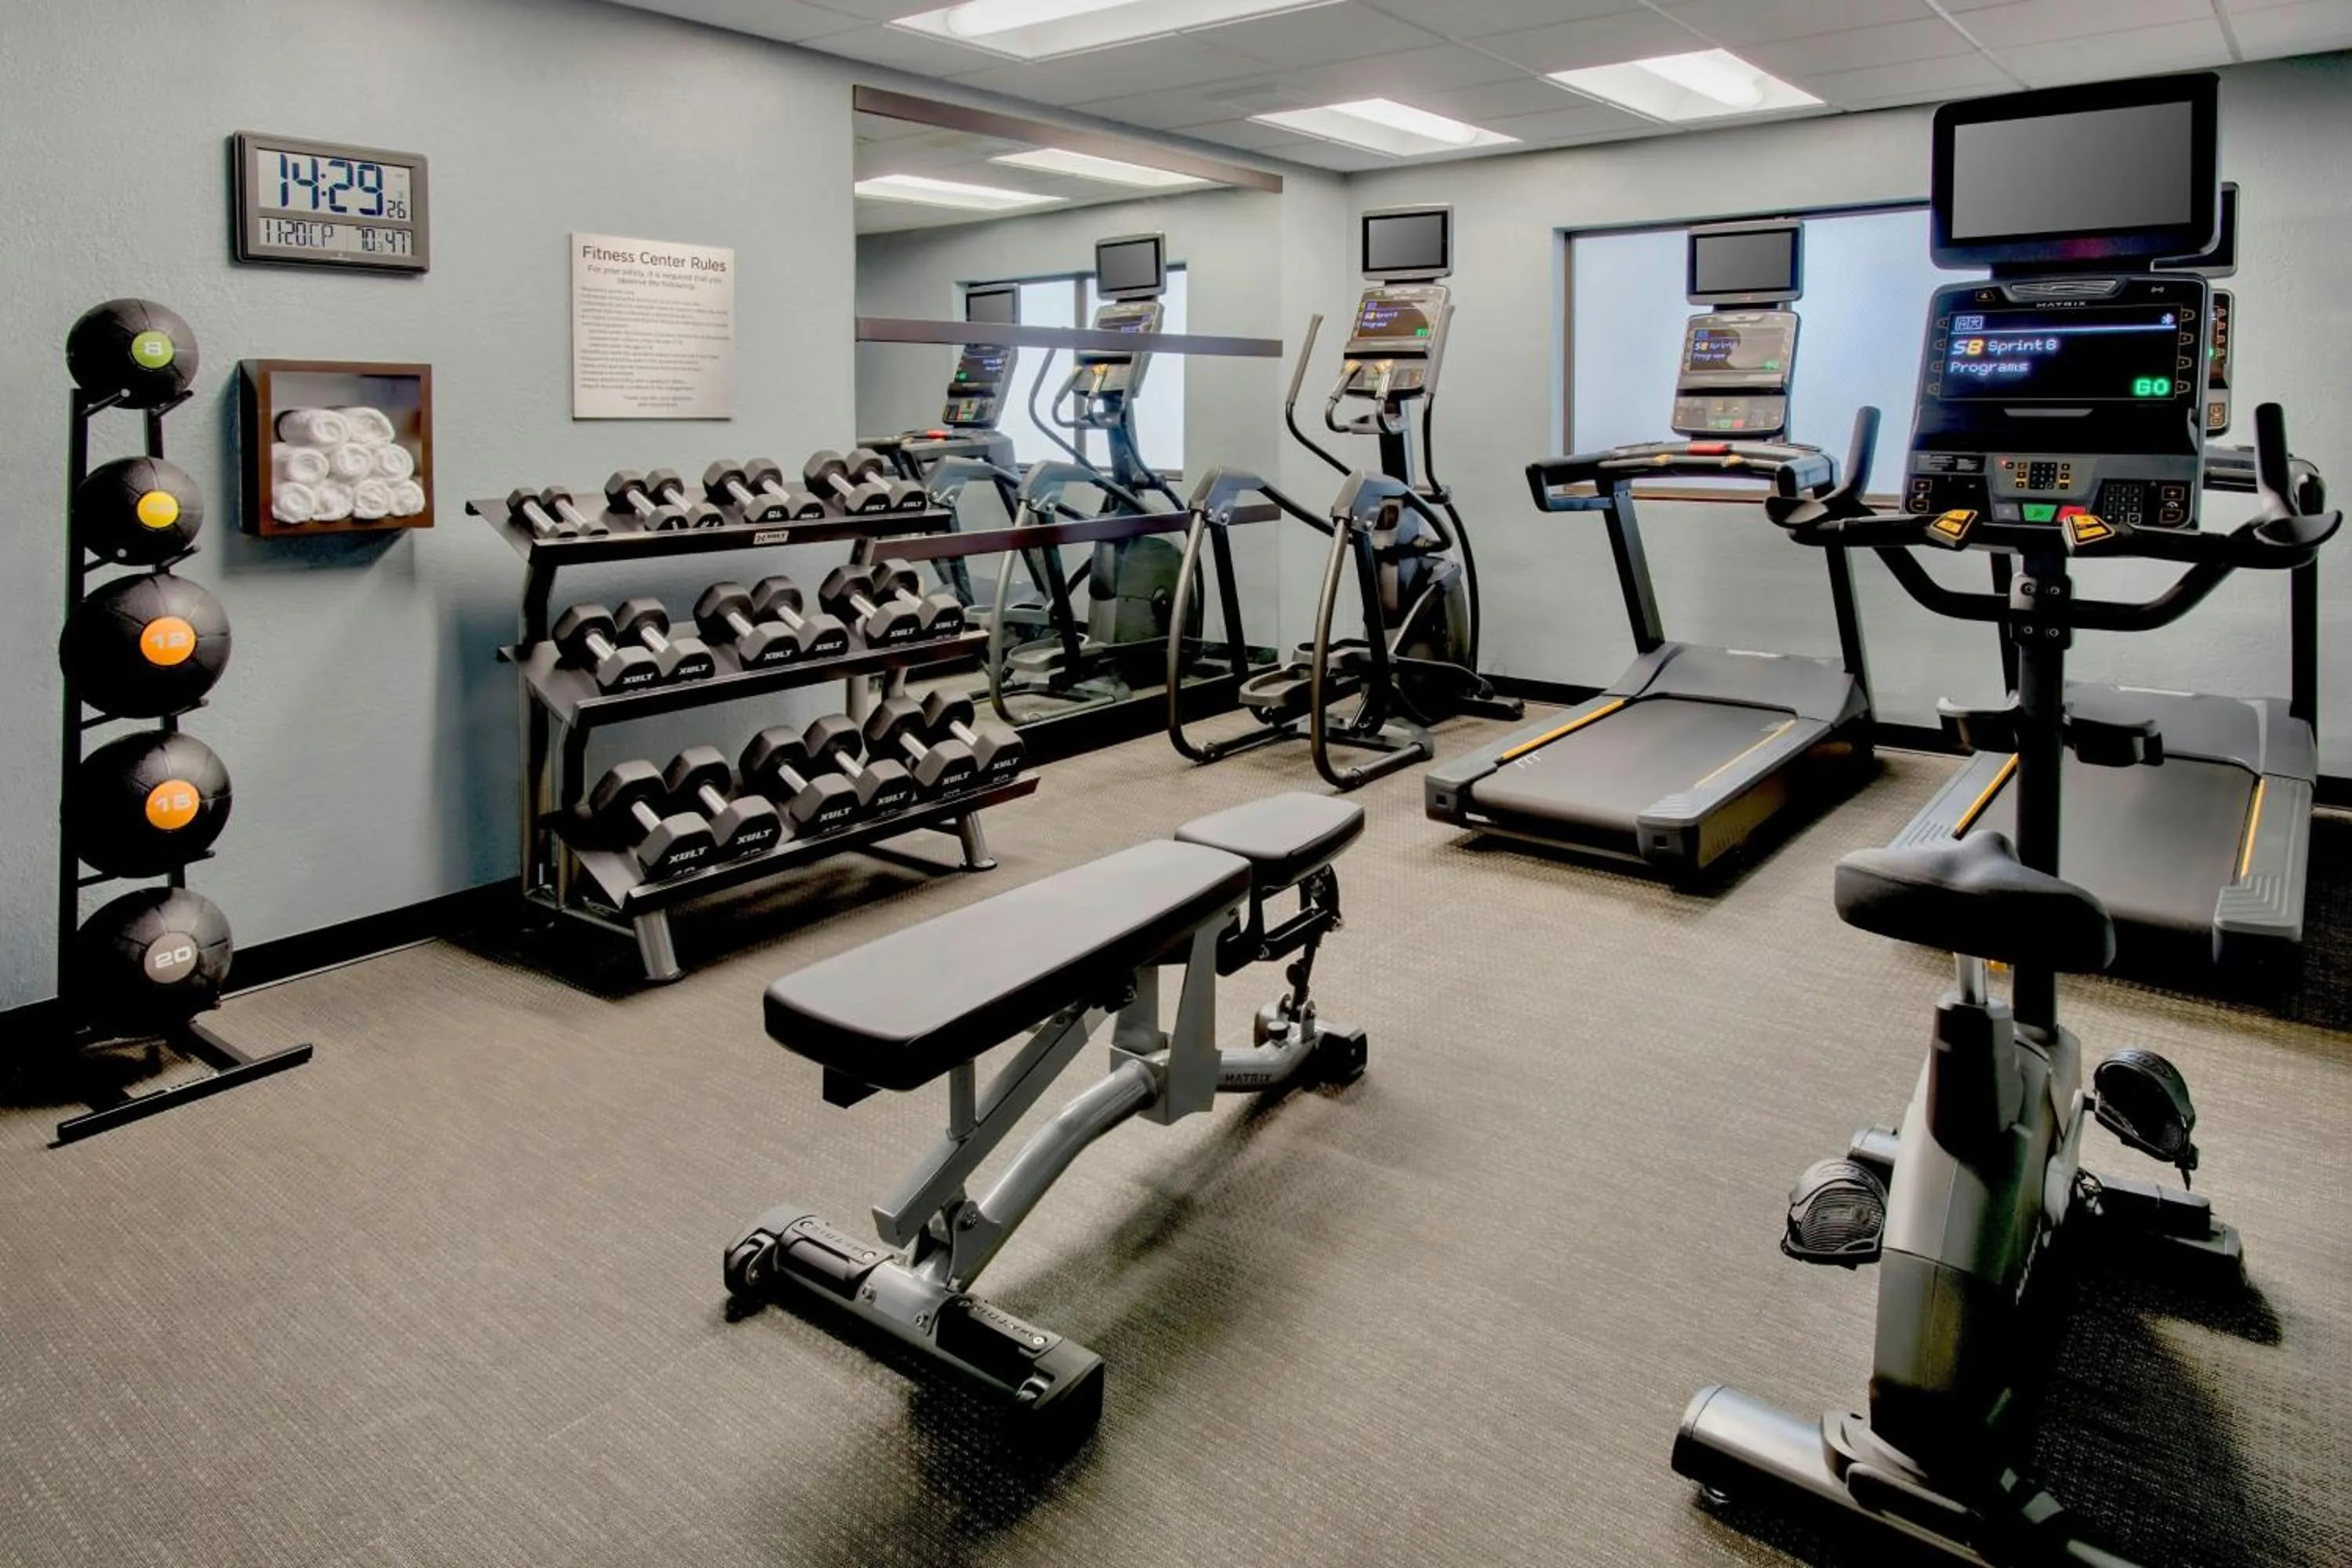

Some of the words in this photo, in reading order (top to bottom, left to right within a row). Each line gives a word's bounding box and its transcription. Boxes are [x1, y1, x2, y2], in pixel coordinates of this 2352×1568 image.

[280, 154, 383, 216] 14:29
[583, 245, 635, 263] Fitness
[640, 252, 686, 268] Center
[691, 256, 727, 272] Rules
[144, 341, 162, 356] 8
[1987, 339, 2042, 354] Sprint
[1950, 361, 2029, 376] Programs
[2135, 377, 2170, 397] GO
[877, 790, 907, 806] XULT
[819, 807, 852, 822] XULT
[735, 828, 773, 845] XULT
[668, 846, 708, 865] XULT
[154, 946, 192, 968] 20
[1224, 1073, 1272, 1083] MATRIX
